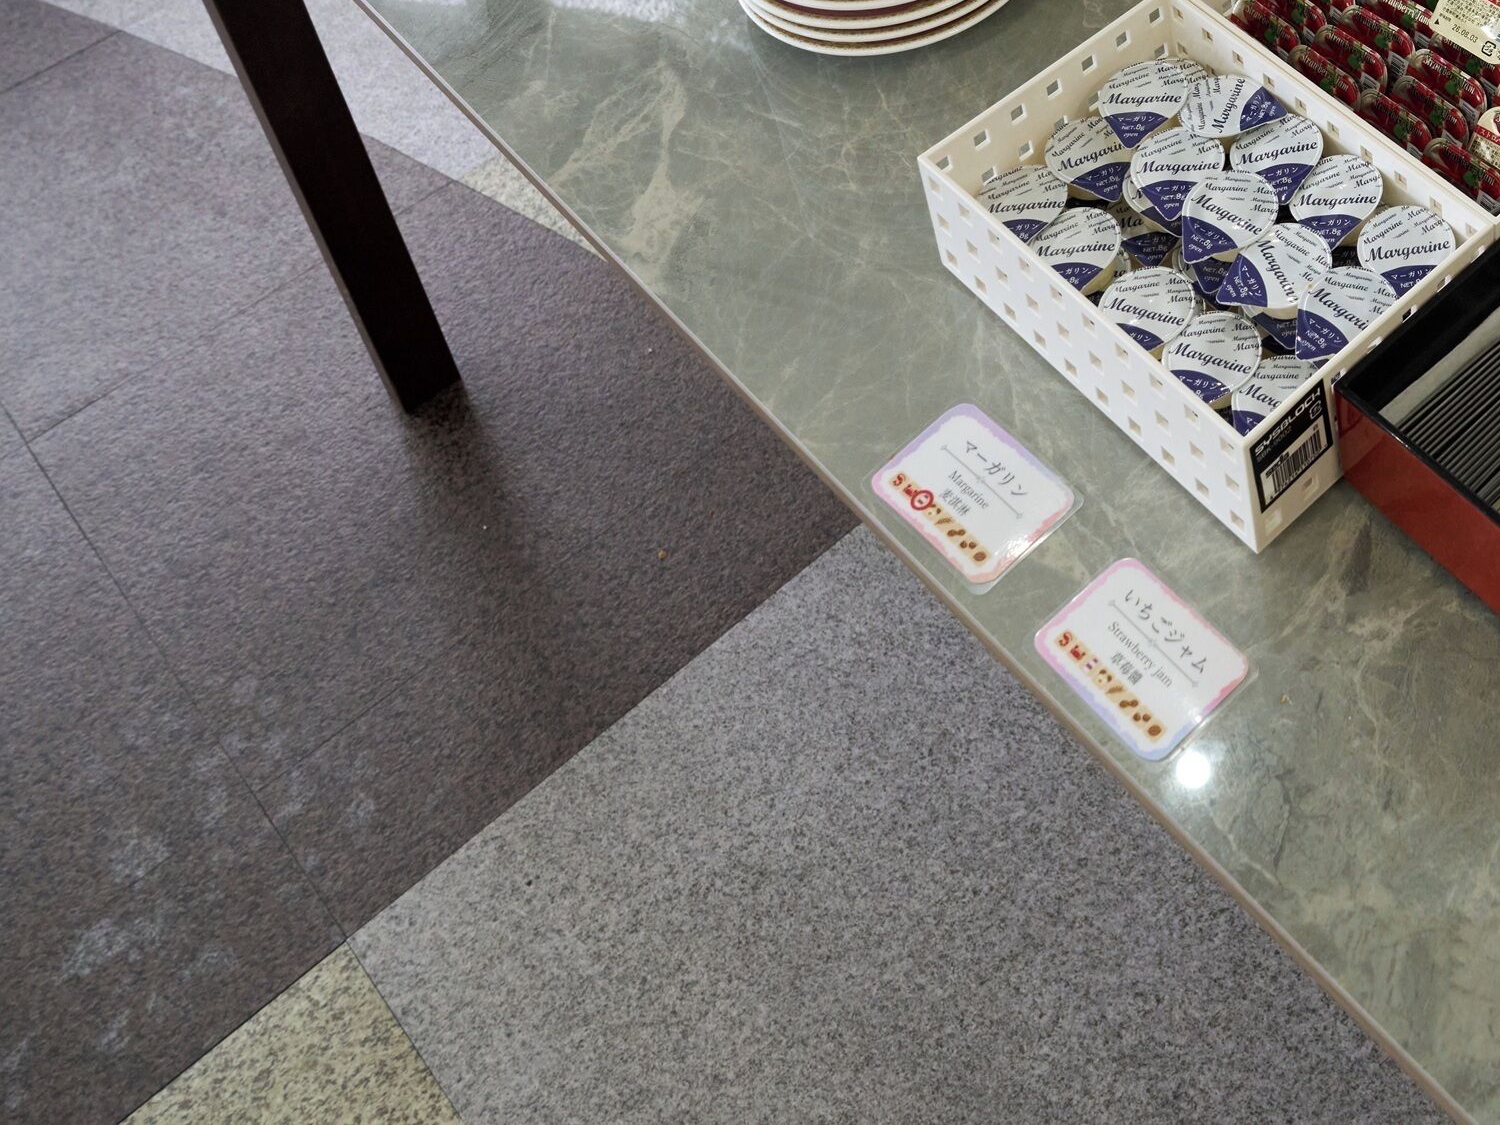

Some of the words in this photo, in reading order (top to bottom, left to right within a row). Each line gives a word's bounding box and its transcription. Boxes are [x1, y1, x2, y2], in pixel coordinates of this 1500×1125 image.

[1451, 23, 1479, 44] 26.08.03
[1109, 72, 1150, 90] Margarine
[1102, 92, 1182, 107] Margarine
[1211, 78, 1246, 134] Margarine
[1051, 131, 1086, 158] Margarine
[1140, 139, 1183, 159] Margarine
[1235, 127, 1275, 151] Margarine
[1236, 141, 1319, 166] Margarine
[1136, 160, 1220, 175] Margarine
[987, 180, 1030, 201] Margarine
[1205, 182, 1249, 193] Margarine
[988, 198, 1066, 214] Margarine
[1293, 193, 1378, 210] Margarine
[1191, 194, 1263, 236] Margarine
[1311, 219, 1352, 227] マーガリン
[1035, 221, 1079, 242] Margarine
[1363, 219, 1404, 246] Margarine
[1036, 241, 1116, 258] Margarine
[1275, 229, 1310, 257] Margarine
[1365, 239, 1451, 263] Margarine
[1115, 280, 1161, 293] Margarine
[1324, 276, 1369, 292] Margarine
[1104, 297, 1185, 327] Margarine
[1179, 326, 1227, 338] Margarine
[1308, 319, 1342, 344] マーガリン
[1168, 342, 1252, 375] Margarine
[1252, 372, 1299, 381] Margarine
[1254, 386, 1321, 457] SYSBLOCK
[965, 440, 1028, 497] マーガリン
[948, 470, 989, 510] Margarine
[1125, 589, 1207, 674] いちごジャム
[1108, 621, 1155, 672] Strawberry
[1151, 666, 1174, 688] jam
